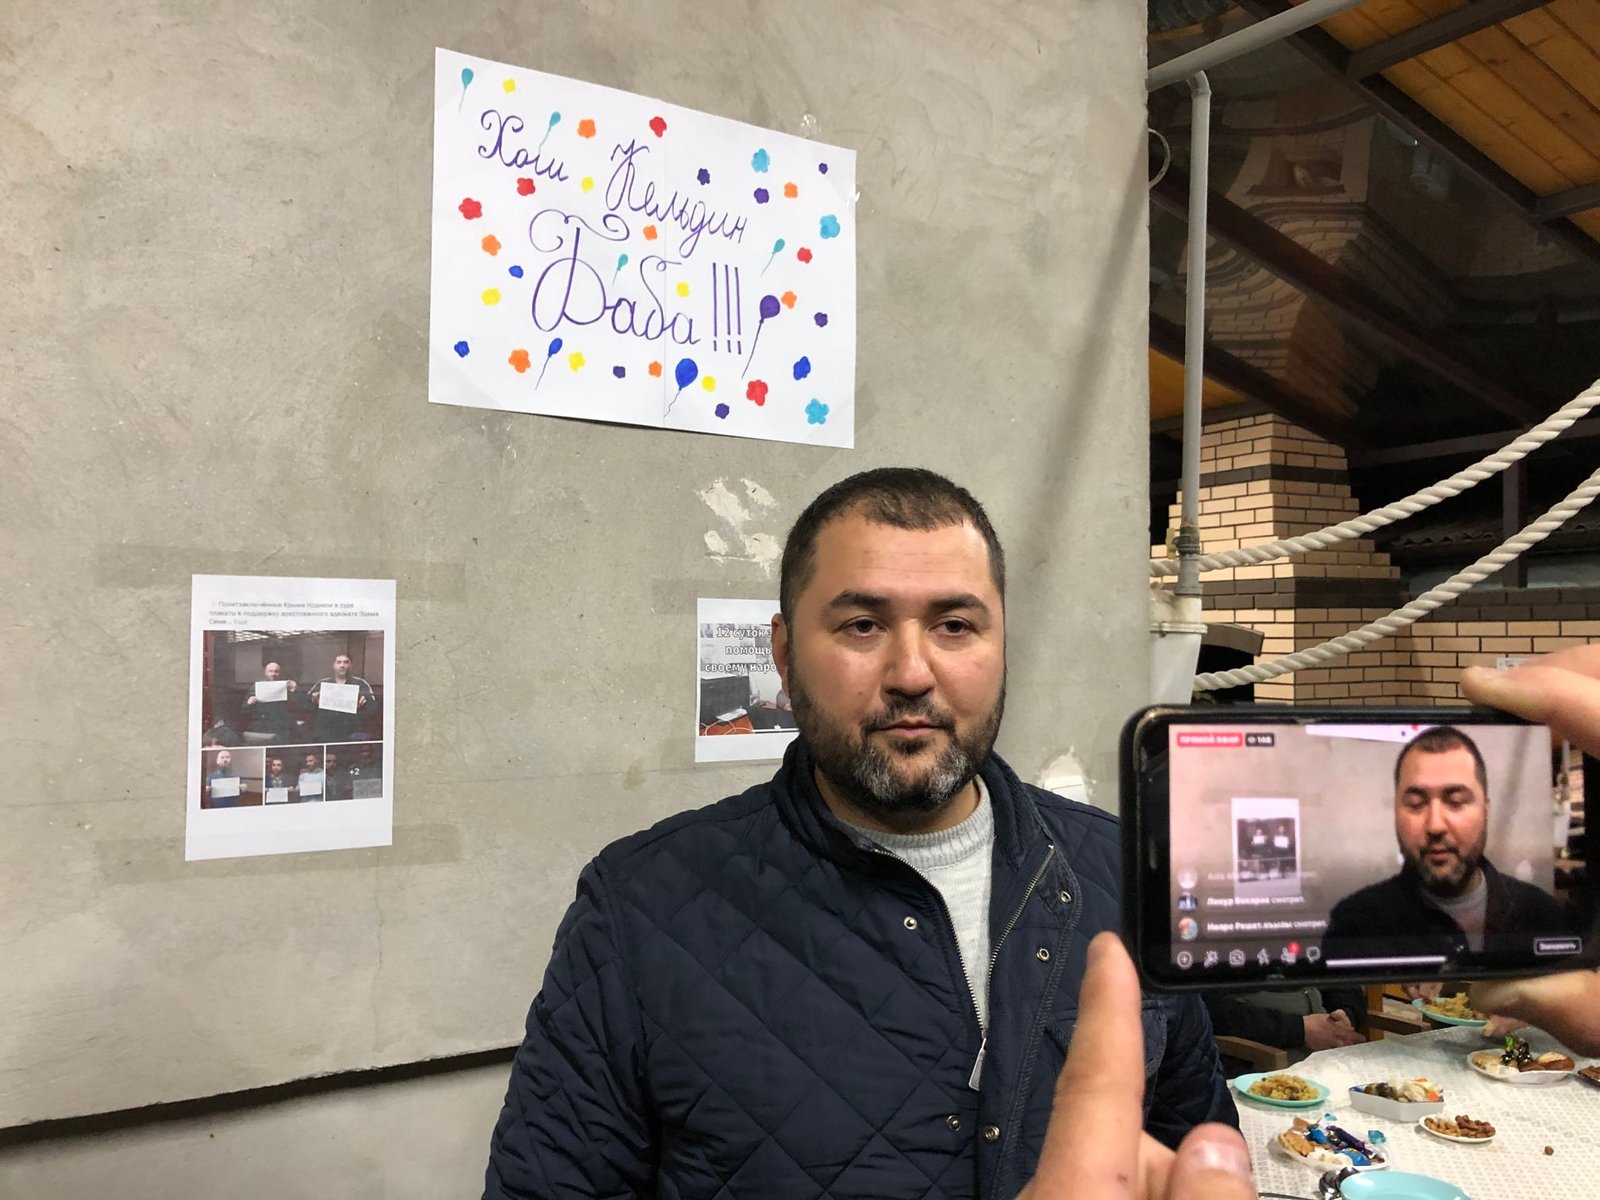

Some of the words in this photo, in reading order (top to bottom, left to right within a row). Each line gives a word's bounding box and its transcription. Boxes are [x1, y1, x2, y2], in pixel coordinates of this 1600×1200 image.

[478, 109, 569, 182] Хош
[716, 626, 730, 638] 12
[732, 628, 765, 641] суток
[705, 663, 747, 675] своему
[750, 663, 776, 674] наро
[349, 767, 360, 776] +2
